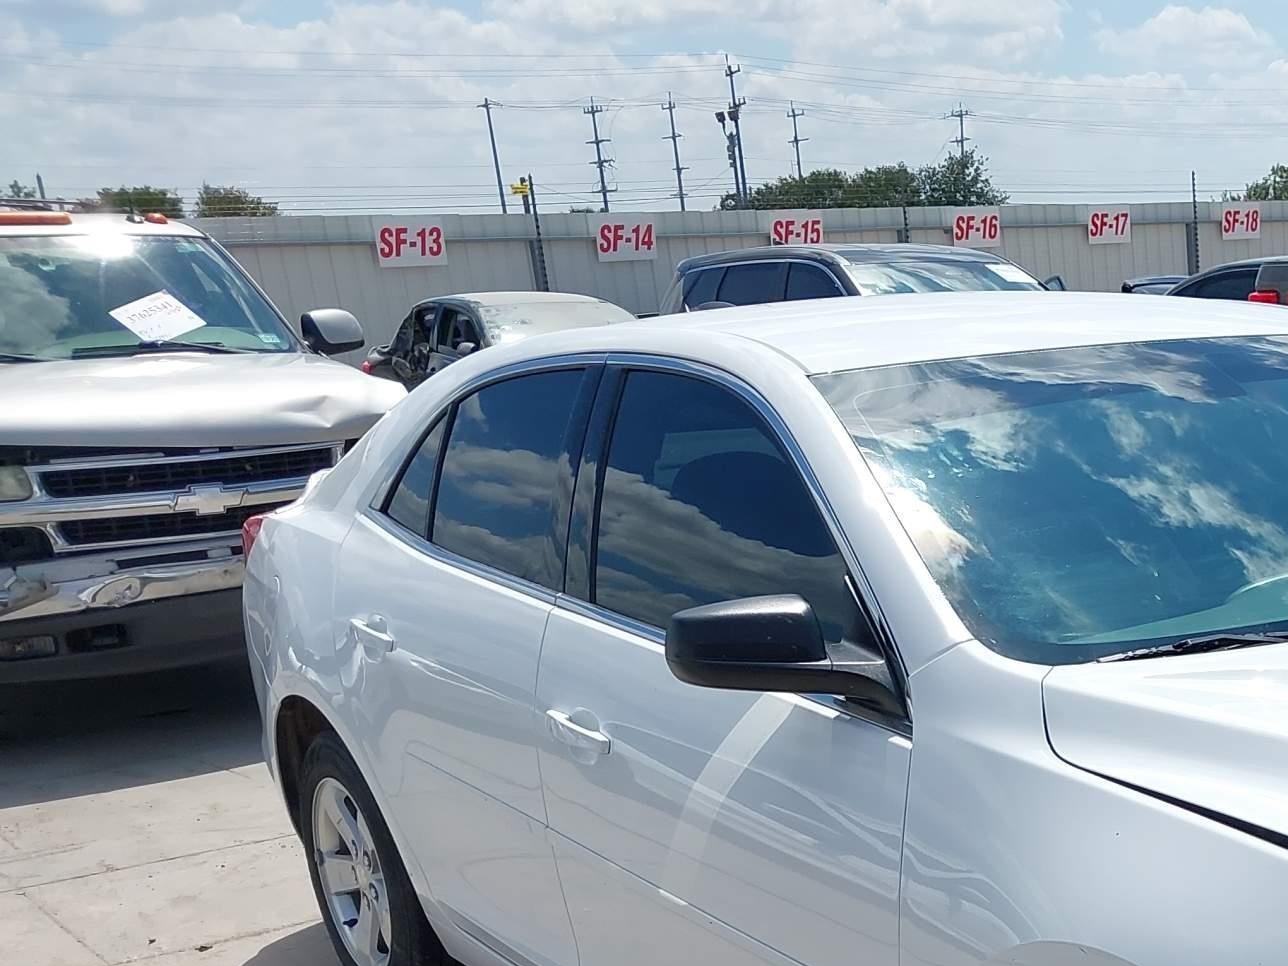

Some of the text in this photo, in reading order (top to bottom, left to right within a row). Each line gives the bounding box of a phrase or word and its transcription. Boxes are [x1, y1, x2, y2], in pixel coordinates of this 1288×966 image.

[773, 219, 821, 244] SF-15
[955, 215, 998, 241] SF-16
[1090, 212, 1129, 237] SF-17
[1223, 210, 1259, 233] SF-18
[380, 227, 442, 258] SF-13
[600, 224, 654, 253] SF-14
